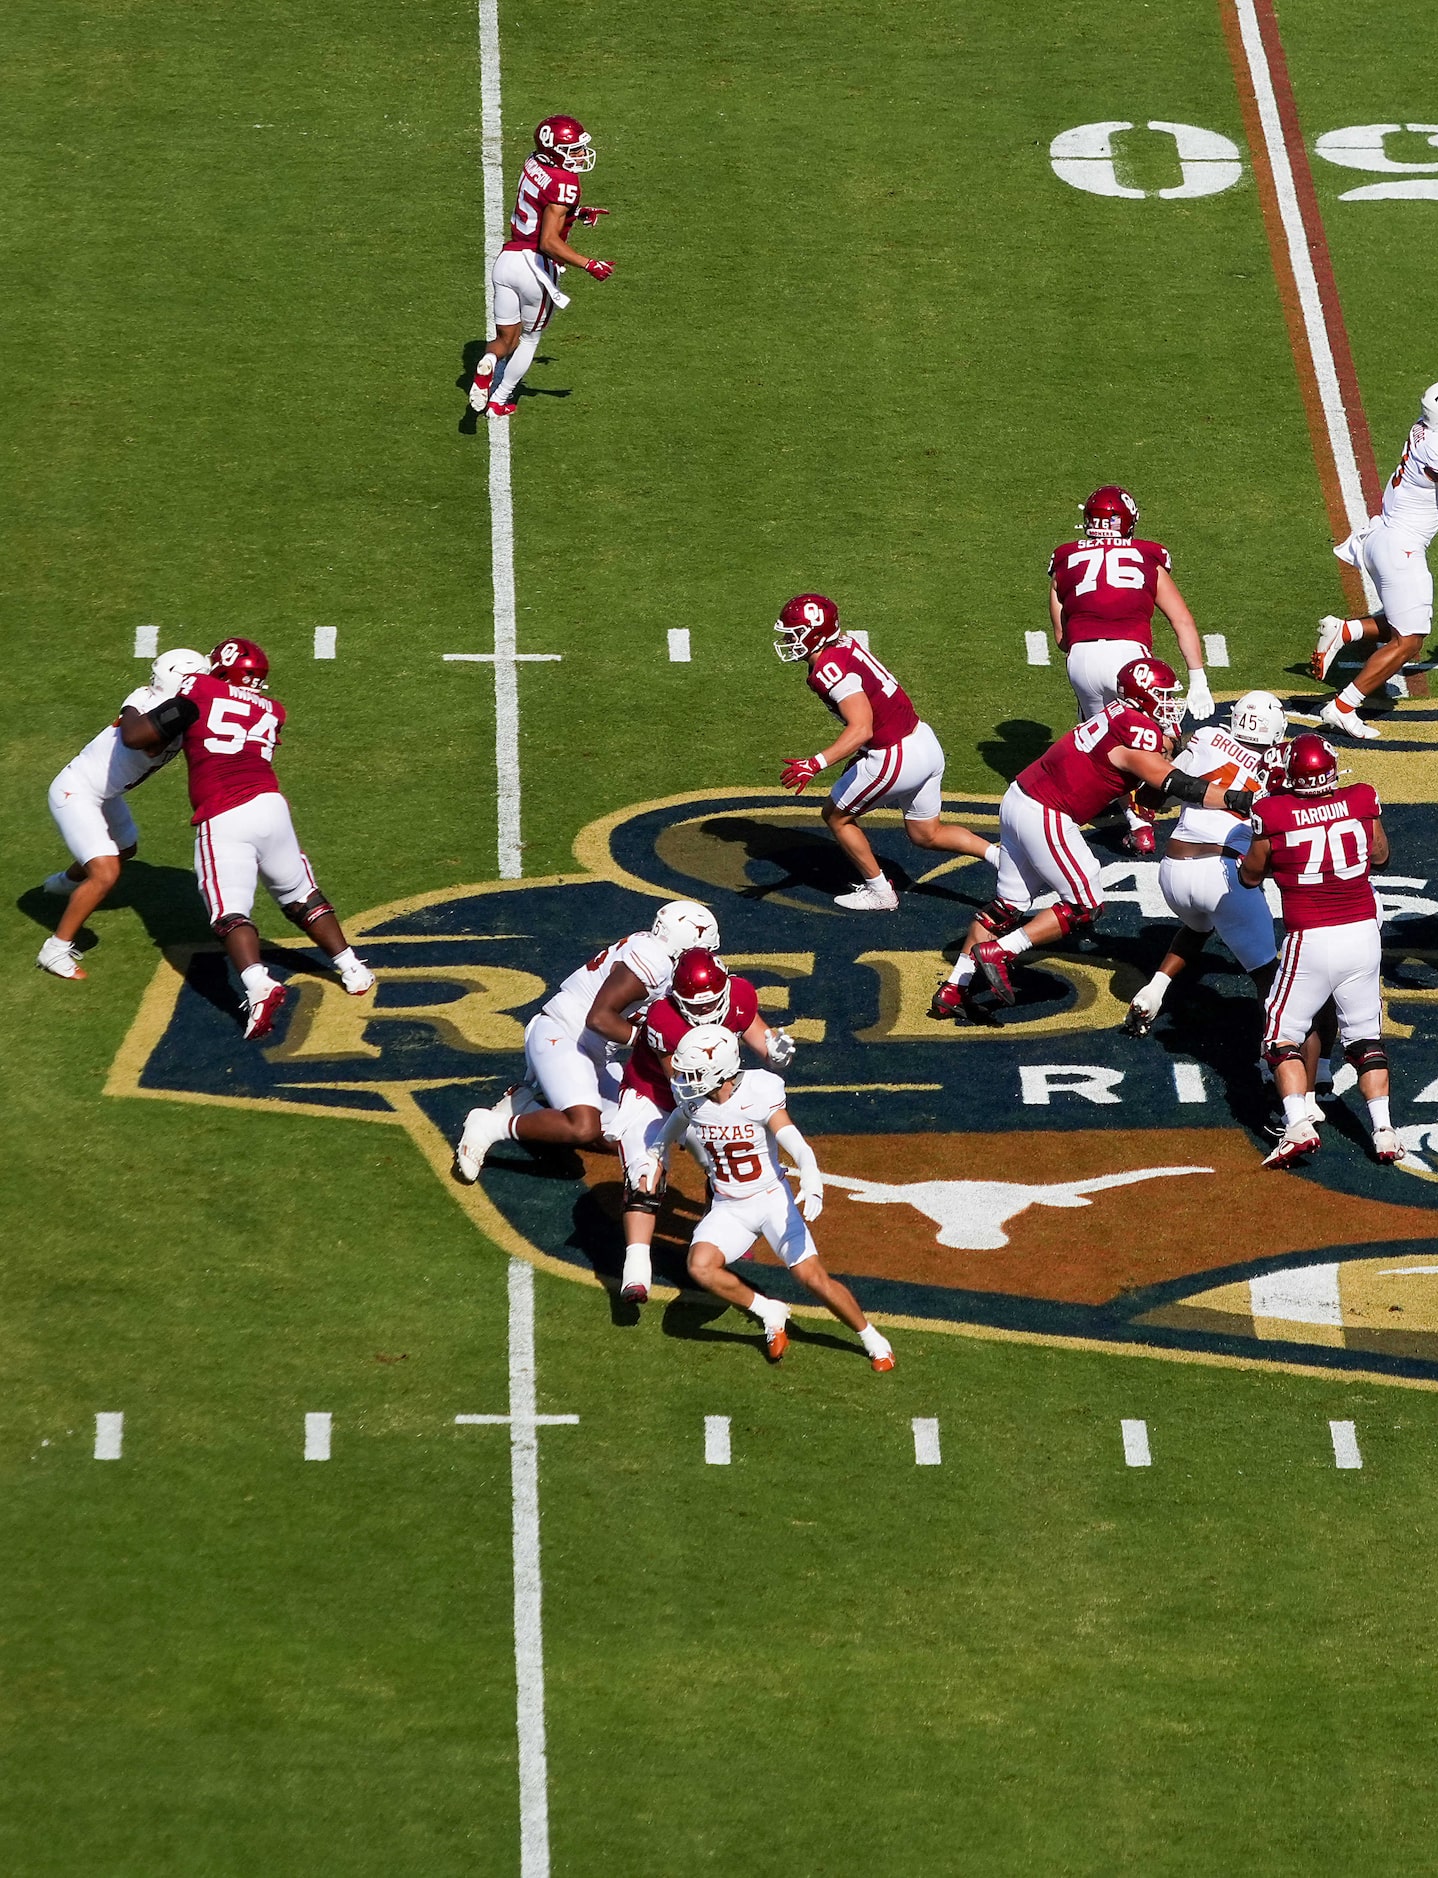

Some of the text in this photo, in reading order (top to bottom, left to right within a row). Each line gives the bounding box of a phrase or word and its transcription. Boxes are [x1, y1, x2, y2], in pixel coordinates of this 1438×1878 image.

[557, 183, 578, 203] 15
[1093, 518, 1109, 529] 76
[1078, 538, 1132, 549] SEXTON
[1067, 547, 1146, 597] 76
[803, 602, 824, 627] OU
[220, 643, 239, 667] OU
[179, 674, 197, 696] 4
[815, 661, 844, 690] 10
[203, 697, 279, 763] 54
[1238, 713, 1258, 732] 45
[1128, 726, 1158, 752] 79
[1308, 773, 1327, 787] 70
[1291, 800, 1350, 827] TARQUIN
[1285, 818, 1369, 885] 70
[700, 1123, 755, 1141] TEXAS
[703, 1141, 762, 1183] 16
